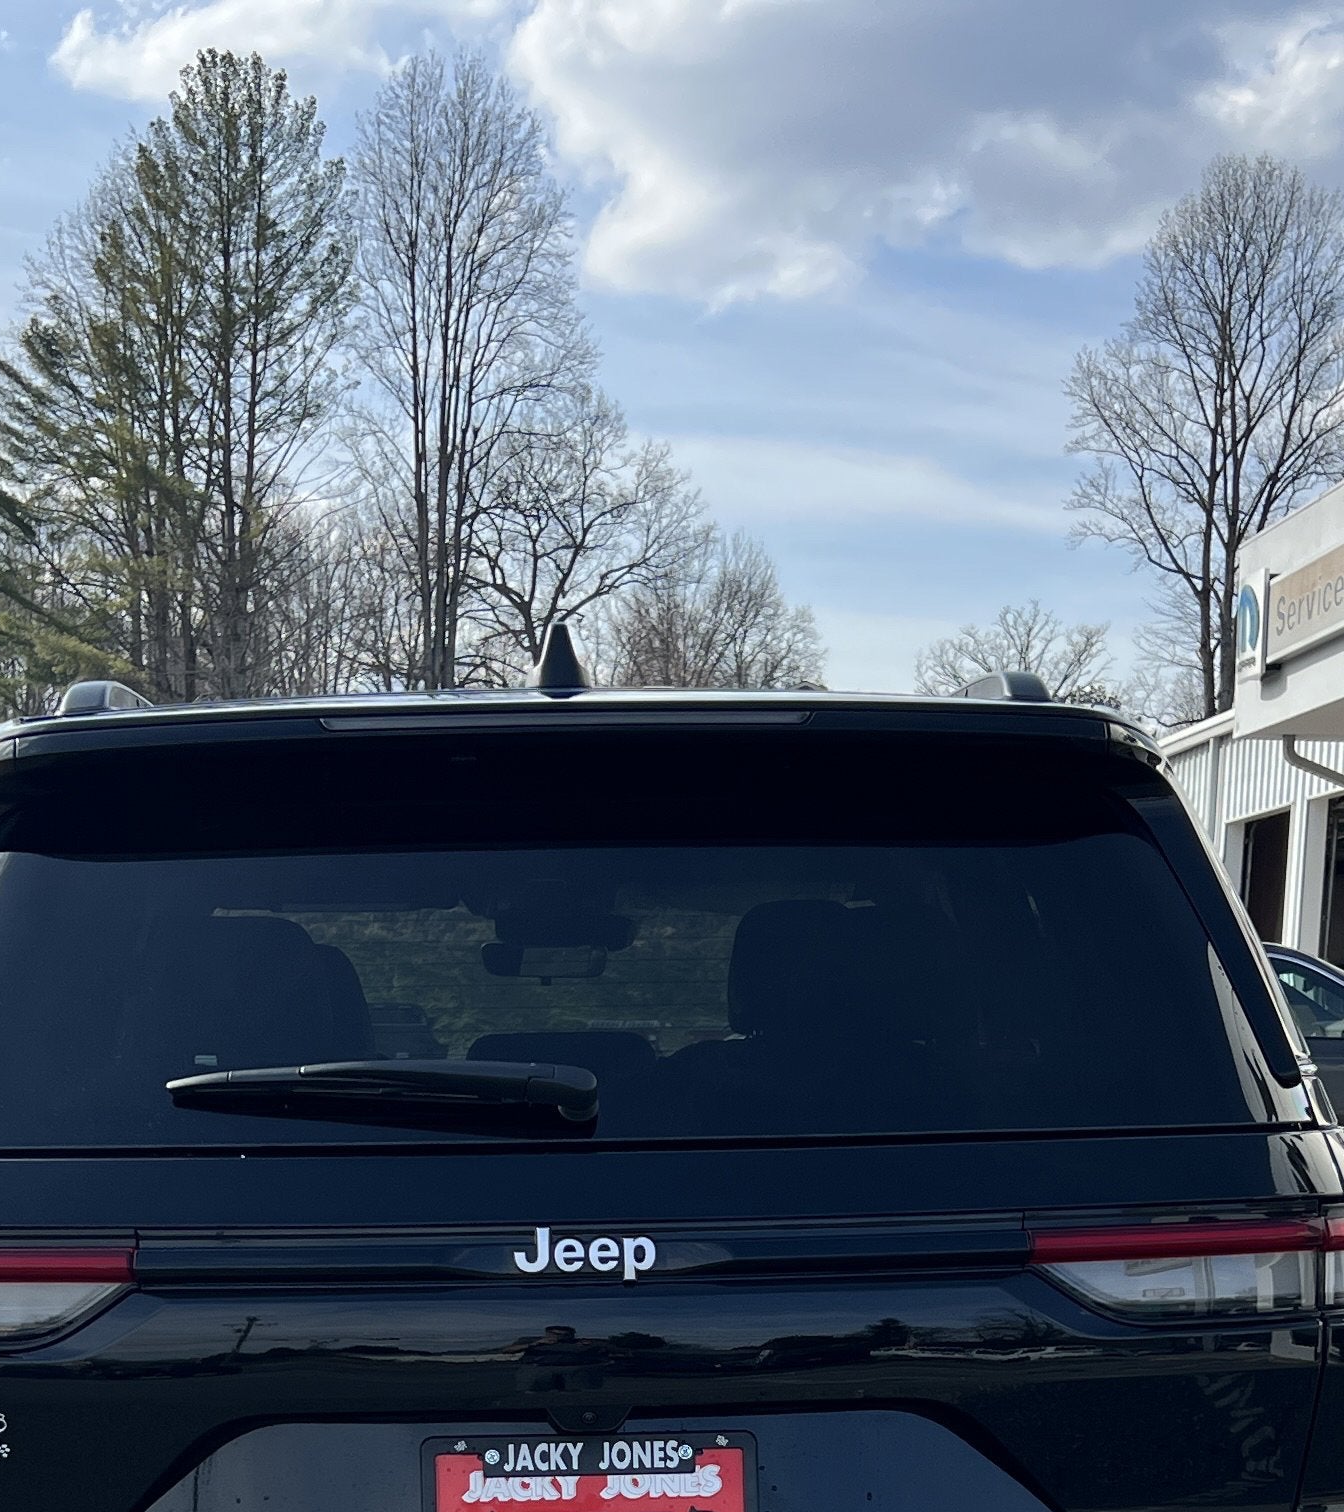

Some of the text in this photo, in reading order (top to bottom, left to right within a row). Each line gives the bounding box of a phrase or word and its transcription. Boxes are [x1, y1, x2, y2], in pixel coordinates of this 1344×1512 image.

[1275, 575, 1344, 637] Service
[513, 1226, 657, 1281] Jeep
[503, 1439, 680, 1472] JACKY JONES
[461, 1463, 724, 1503] JACKY JONES
